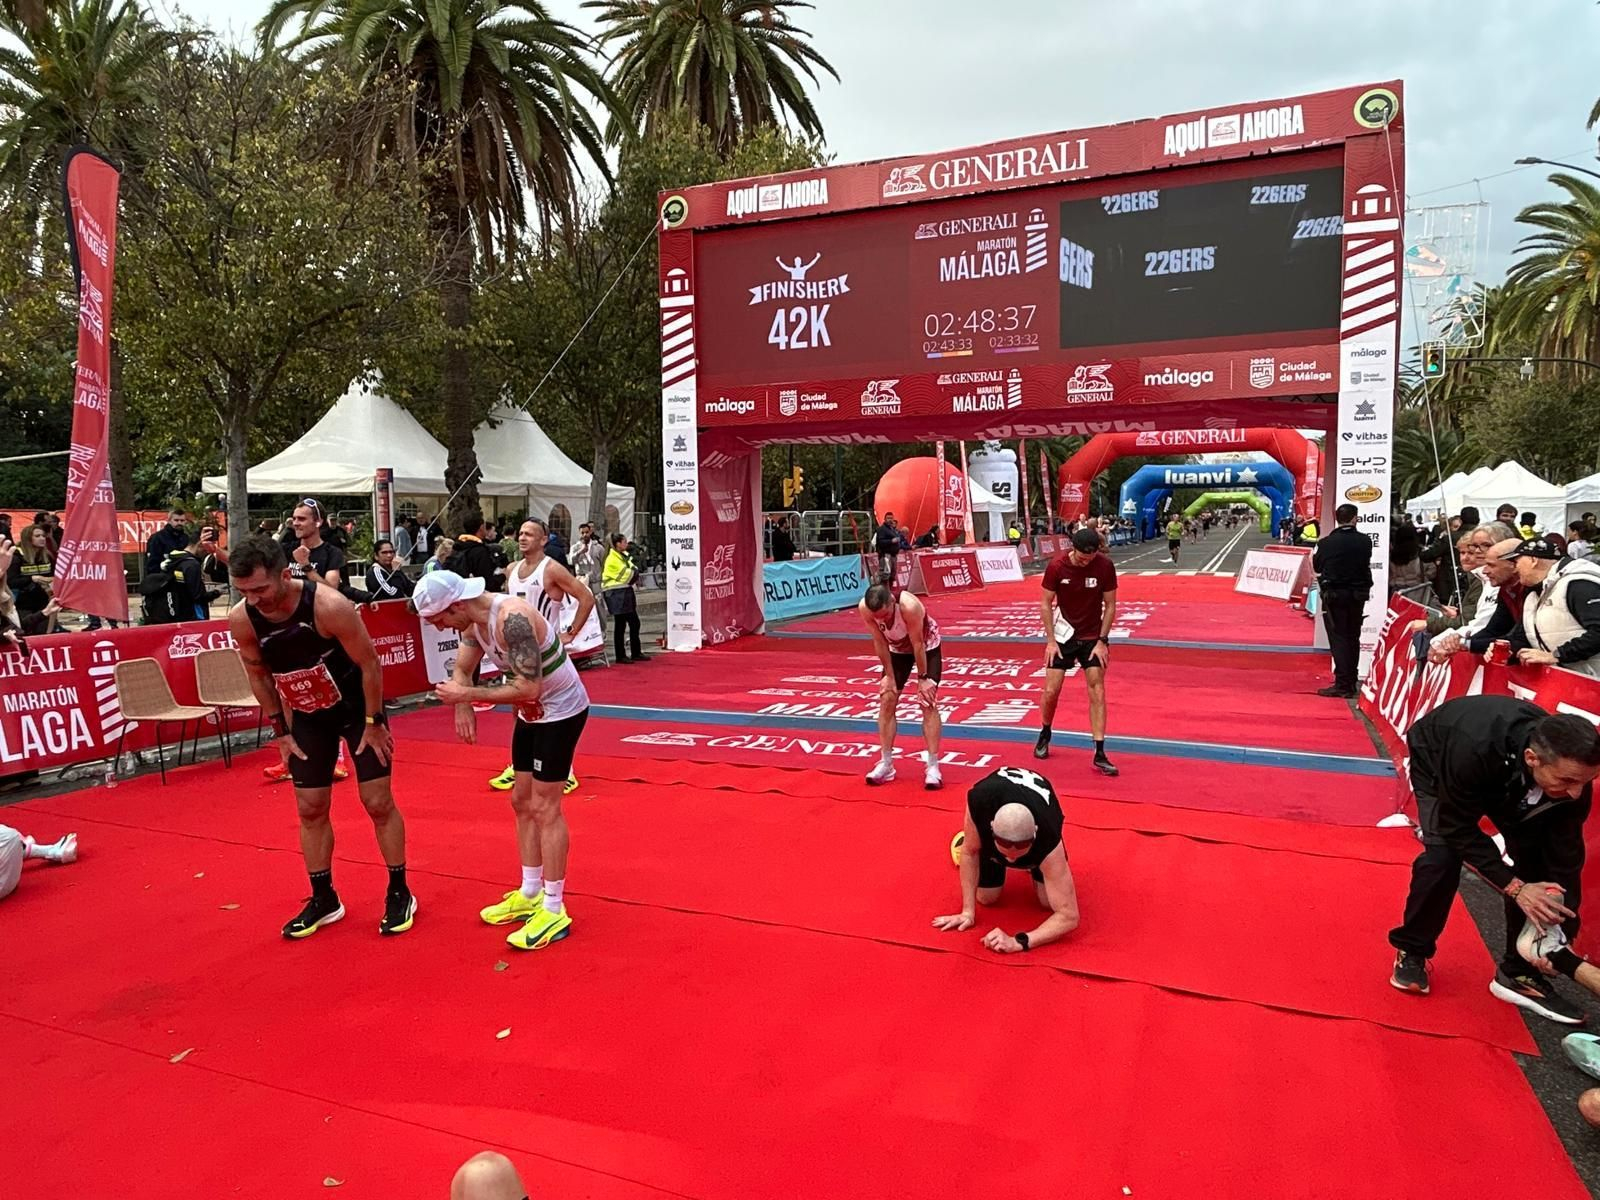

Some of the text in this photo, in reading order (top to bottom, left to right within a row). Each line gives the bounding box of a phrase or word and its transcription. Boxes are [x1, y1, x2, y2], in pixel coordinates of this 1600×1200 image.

[1164, 104, 1304, 157] AQUÍ AHORA
[929, 139, 1088, 190] GENERALI
[727, 178, 828, 218] AQUÍ AHORA
[1101, 190, 1159, 215] 226ERS
[1250, 184, 1307, 204] 226ERS
[939, 212, 1018, 237] GENERALI
[977, 236, 1017, 252] MARATÓN
[940, 250, 1020, 282] MÁLAGA
[1144, 247, 1215, 276] 226ERS
[763, 279, 839, 301] FINISHER
[768, 304, 831, 350] 42K
[924, 304, 1037, 337] 02:48:37
[922, 338, 973, 353] 02:43:33
[989, 333, 1039, 348] 02:33:32
[1279, 361, 1317, 372] Ciudad
[952, 370, 1003, 384] GENERALI
[1279, 370, 1332, 383] de Málaga
[800, 393, 827, 402] Ciudad
[811, 401, 838, 411] Málaga
[952, 392, 1004, 413] MÁLAGA
[1067, 391, 1114, 404] GENERALI
[861, 404, 901, 416] GENERALI
[1161, 428, 1246, 446] GENERALI
[1356, 432, 1388, 441] vithas
[1341, 457, 1387, 467] BYD
[1164, 467, 1231, 484] luanvi
[796, 572, 859, 598] ATHLETICS
[290, 680, 312, 692] 669
[3, 685, 79, 713] MARATÓN
